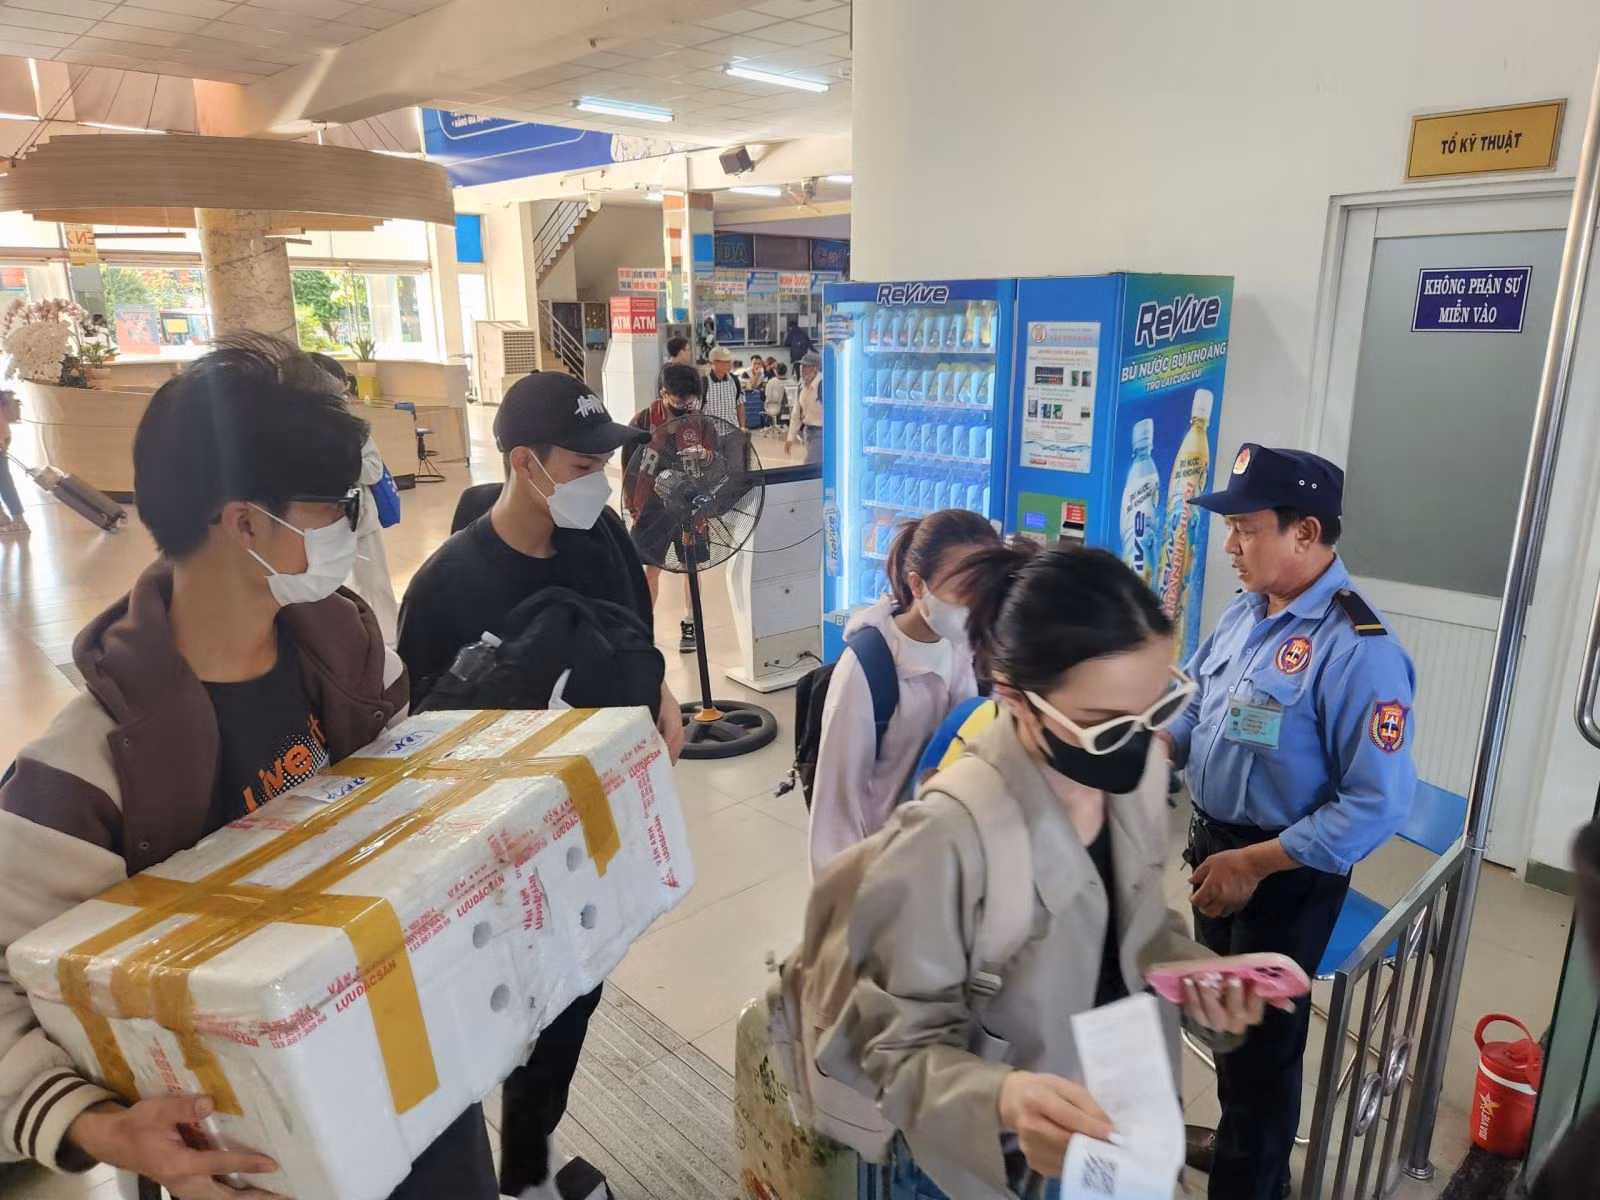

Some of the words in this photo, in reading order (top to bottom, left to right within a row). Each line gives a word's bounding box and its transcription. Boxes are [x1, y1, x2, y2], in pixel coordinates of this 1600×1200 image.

[1440, 131, 1459, 155] TỔ
[1459, 133, 1477, 153] KỸ
[1480, 130, 1522, 153] THUẬT
[1423, 274, 1466, 295] KHÔNG
[1467, 273, 1503, 298] PHẬN
[1504, 274, 1523, 298] SỰ
[613, 315, 631, 329] ATM
[632, 316, 656, 330] ATM
[1438, 299, 1471, 323] MIỄN
[1473, 302, 1497, 323] VÀO
[1121, 361, 1138, 383] BÙ
[1138, 355, 1169, 379] NƯỚC
[1171, 349, 1186, 371] BÙ
